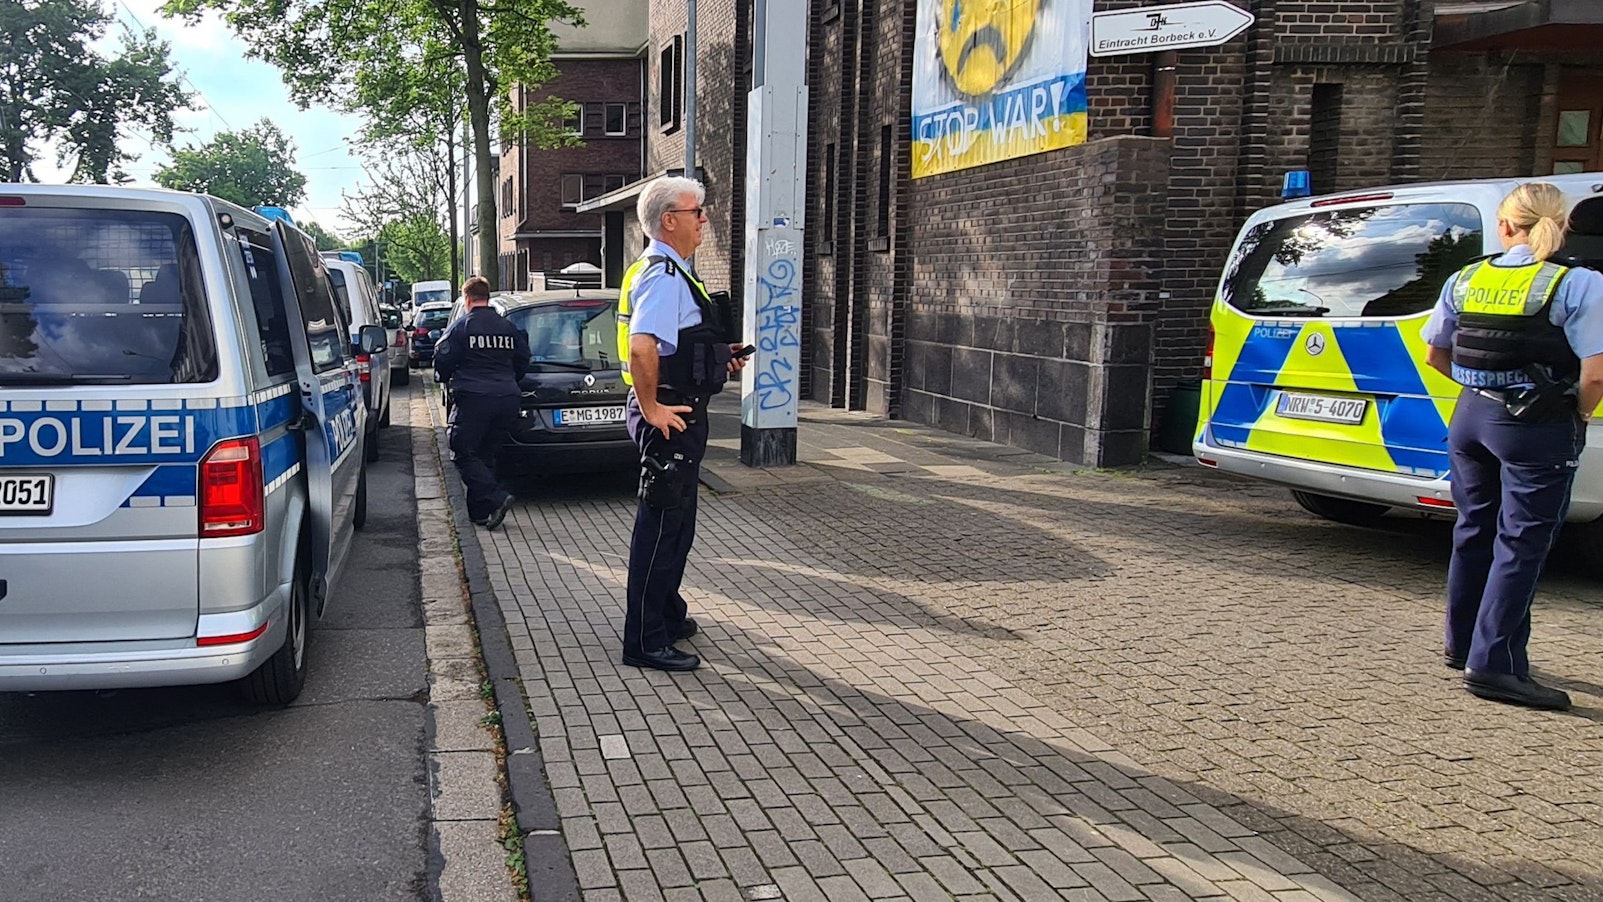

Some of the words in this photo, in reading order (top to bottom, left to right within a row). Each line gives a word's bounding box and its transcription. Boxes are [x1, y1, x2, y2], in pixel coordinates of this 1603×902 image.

[1099, 36, 1147, 49] Eintracht
[1150, 31, 1195, 44] Borbeck
[1198, 28, 1217, 39] e.V.
[919, 106, 979, 162] STOP
[989, 80, 1065, 145] WAR!
[1466, 287, 1525, 306] POLIZEI
[469, 335, 514, 350] POLIZEI
[1254, 327, 1292, 339] POLIZEI
[1285, 396, 1310, 413] NRW
[1314, 399, 1363, 418] 5-4070
[0, 415, 195, 457] POLIZEI
[0, 479, 46, 505] 051
